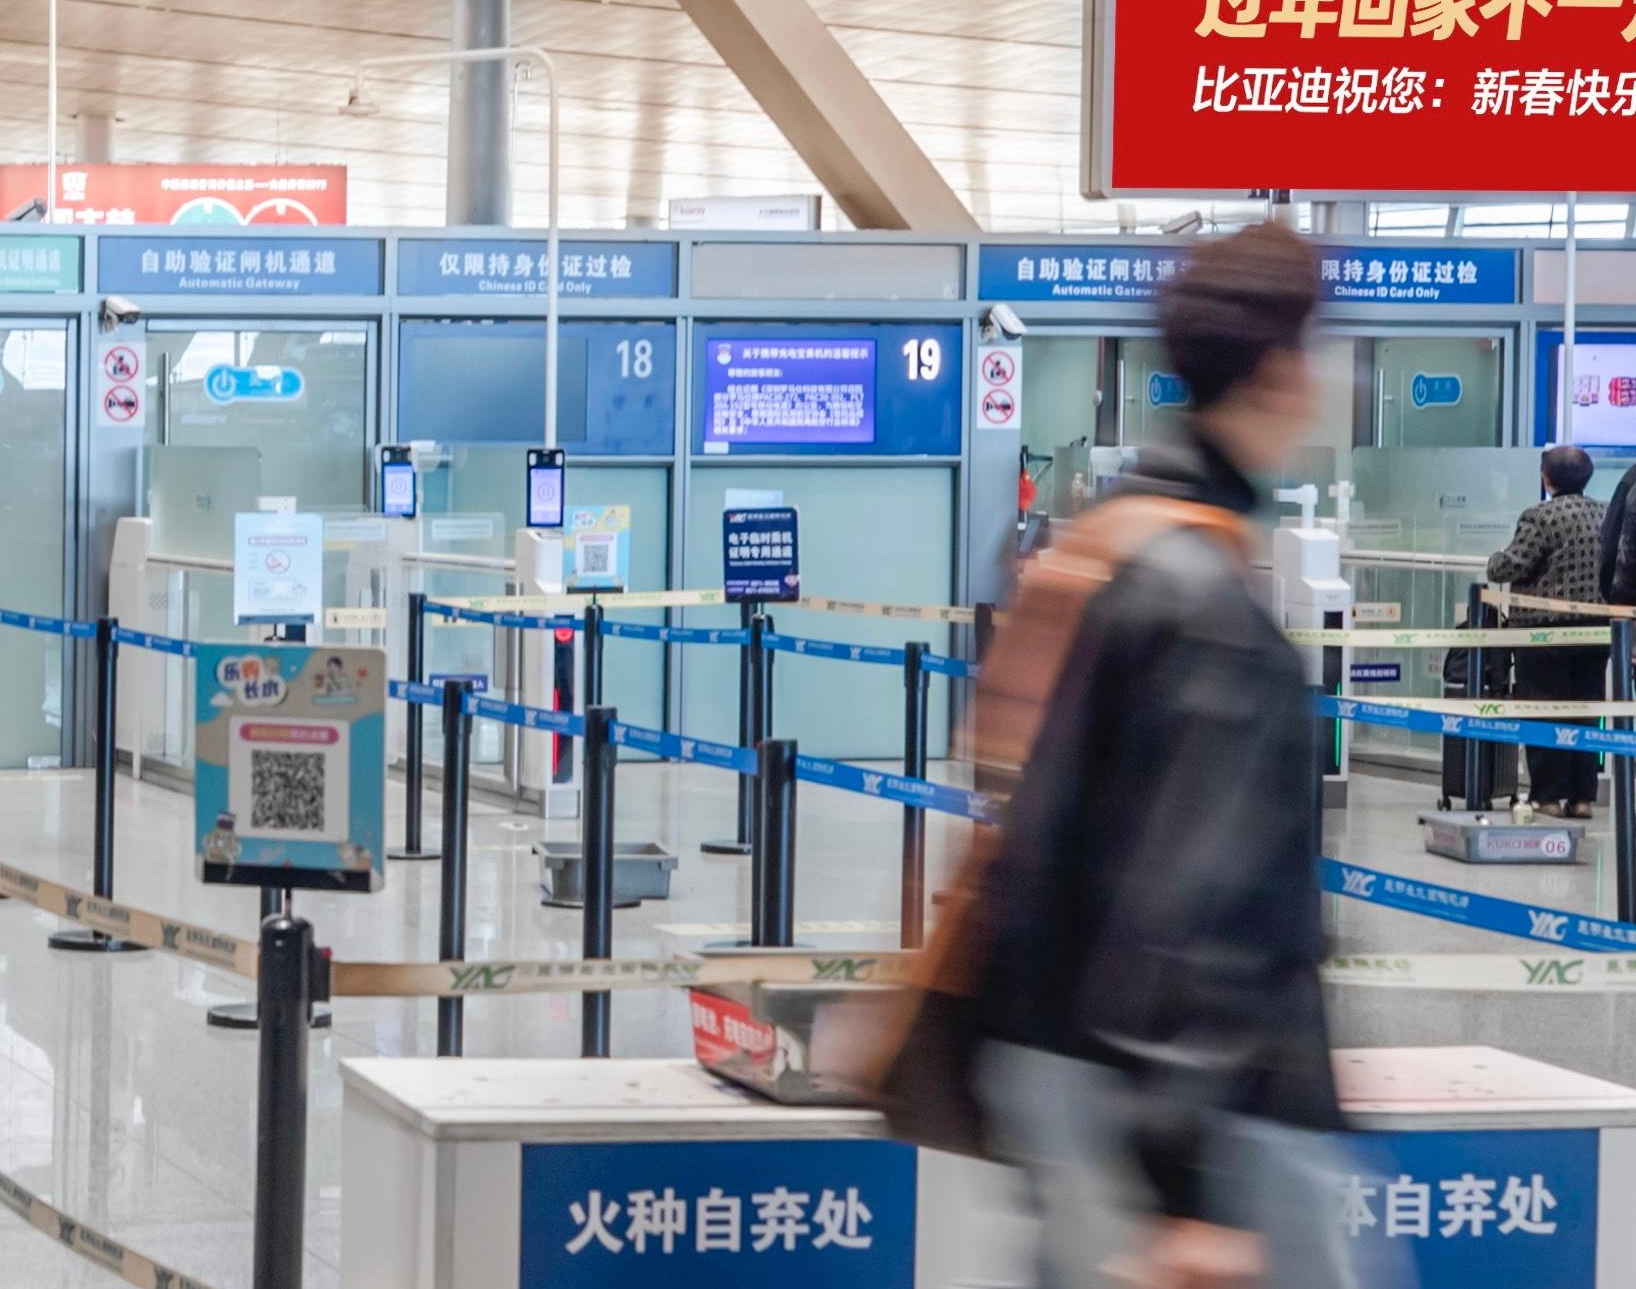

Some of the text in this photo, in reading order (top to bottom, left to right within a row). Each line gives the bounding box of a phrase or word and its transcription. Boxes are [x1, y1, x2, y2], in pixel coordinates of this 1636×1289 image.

[141, 249, 336, 275] 自助验证闸机通道
[1017, 258, 1191, 283] 自助验证闸机通
[1321, 260, 1478, 284] 限持身份证过检
[179, 276, 301, 292] Automatic Gateway
[478, 279, 522, 291] Chinese
[524, 280, 536, 292] ID
[566, 281, 592, 295] Only
[1052, 284, 1159, 299] Automatic Gatew
[1334, 285, 1441, 301] Chinese ID Card Only
[616, 339, 653, 378] 18
[902, 338, 941, 381] 19
[1544, 840, 1567, 853] 06
[1338, 1173, 1558, 1239] 体自弃处
[566, 1187, 874, 1256] 火种自弃处
